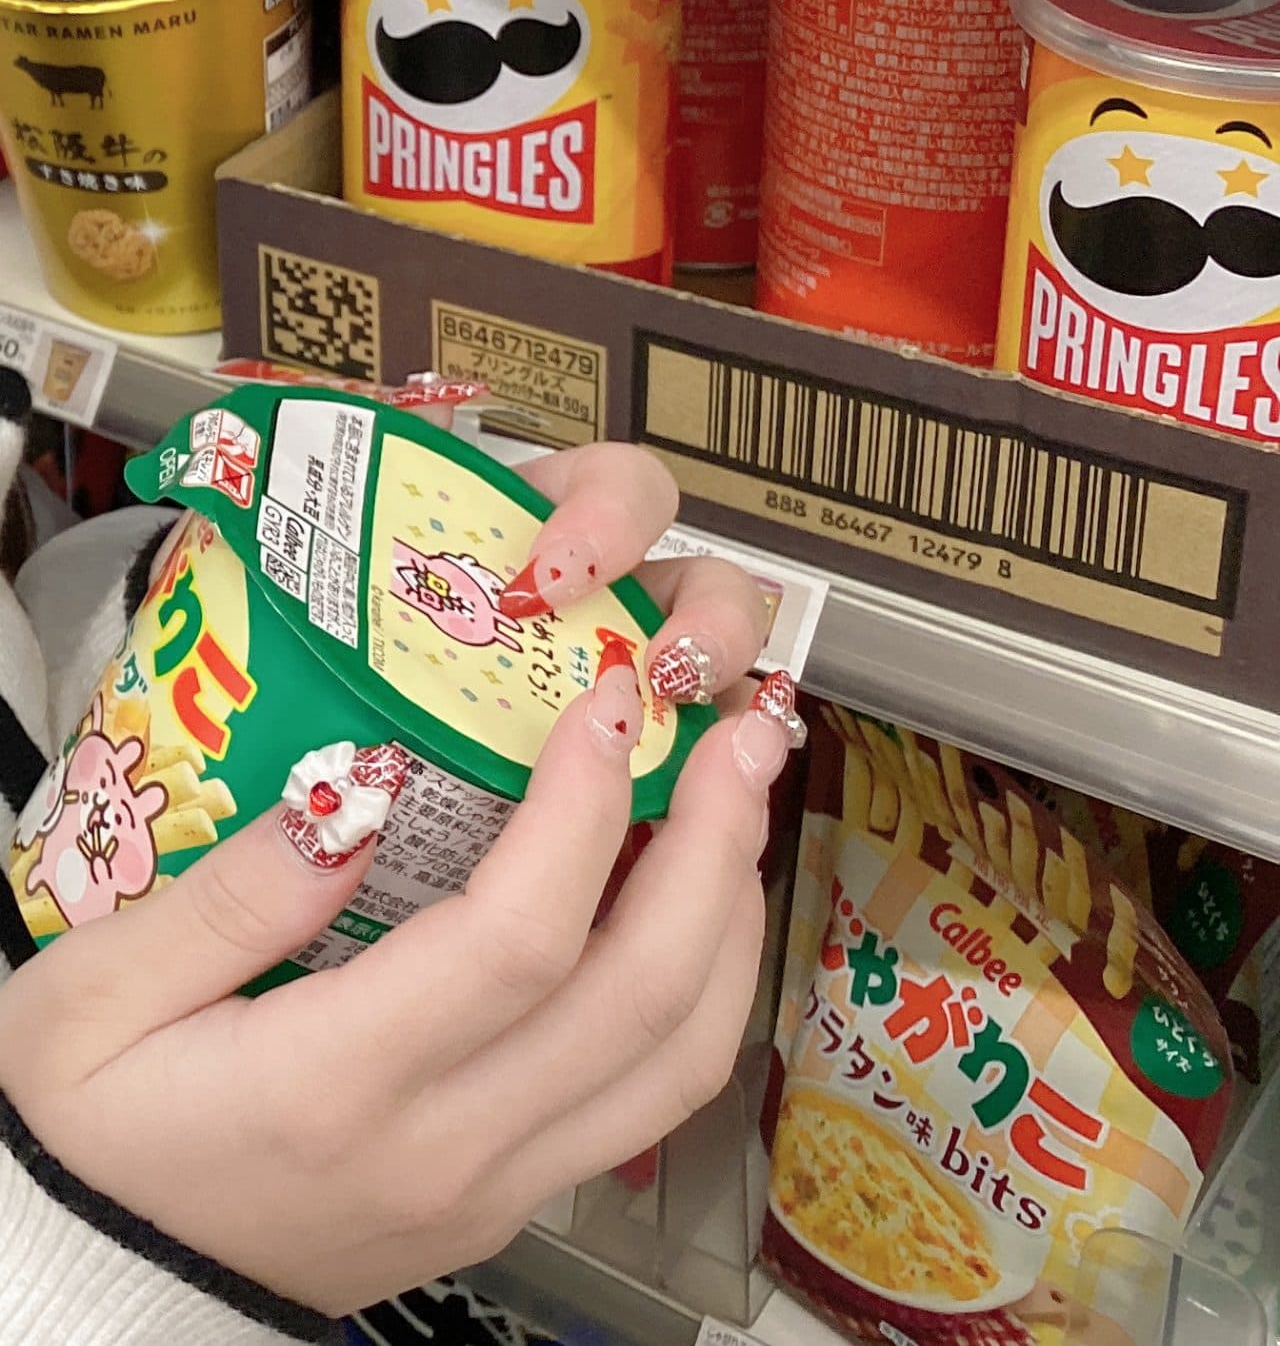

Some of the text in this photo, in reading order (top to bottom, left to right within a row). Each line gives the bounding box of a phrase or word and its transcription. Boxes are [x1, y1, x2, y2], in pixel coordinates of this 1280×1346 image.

[368, 94, 585, 212] PRINGLES
[443, 316, 594, 375] 8646712479
[765, 490, 1012, 579] 888 86467 12479 8
[928, 900, 1024, 999] Calbee
[939, 1126, 1048, 1232] bits
